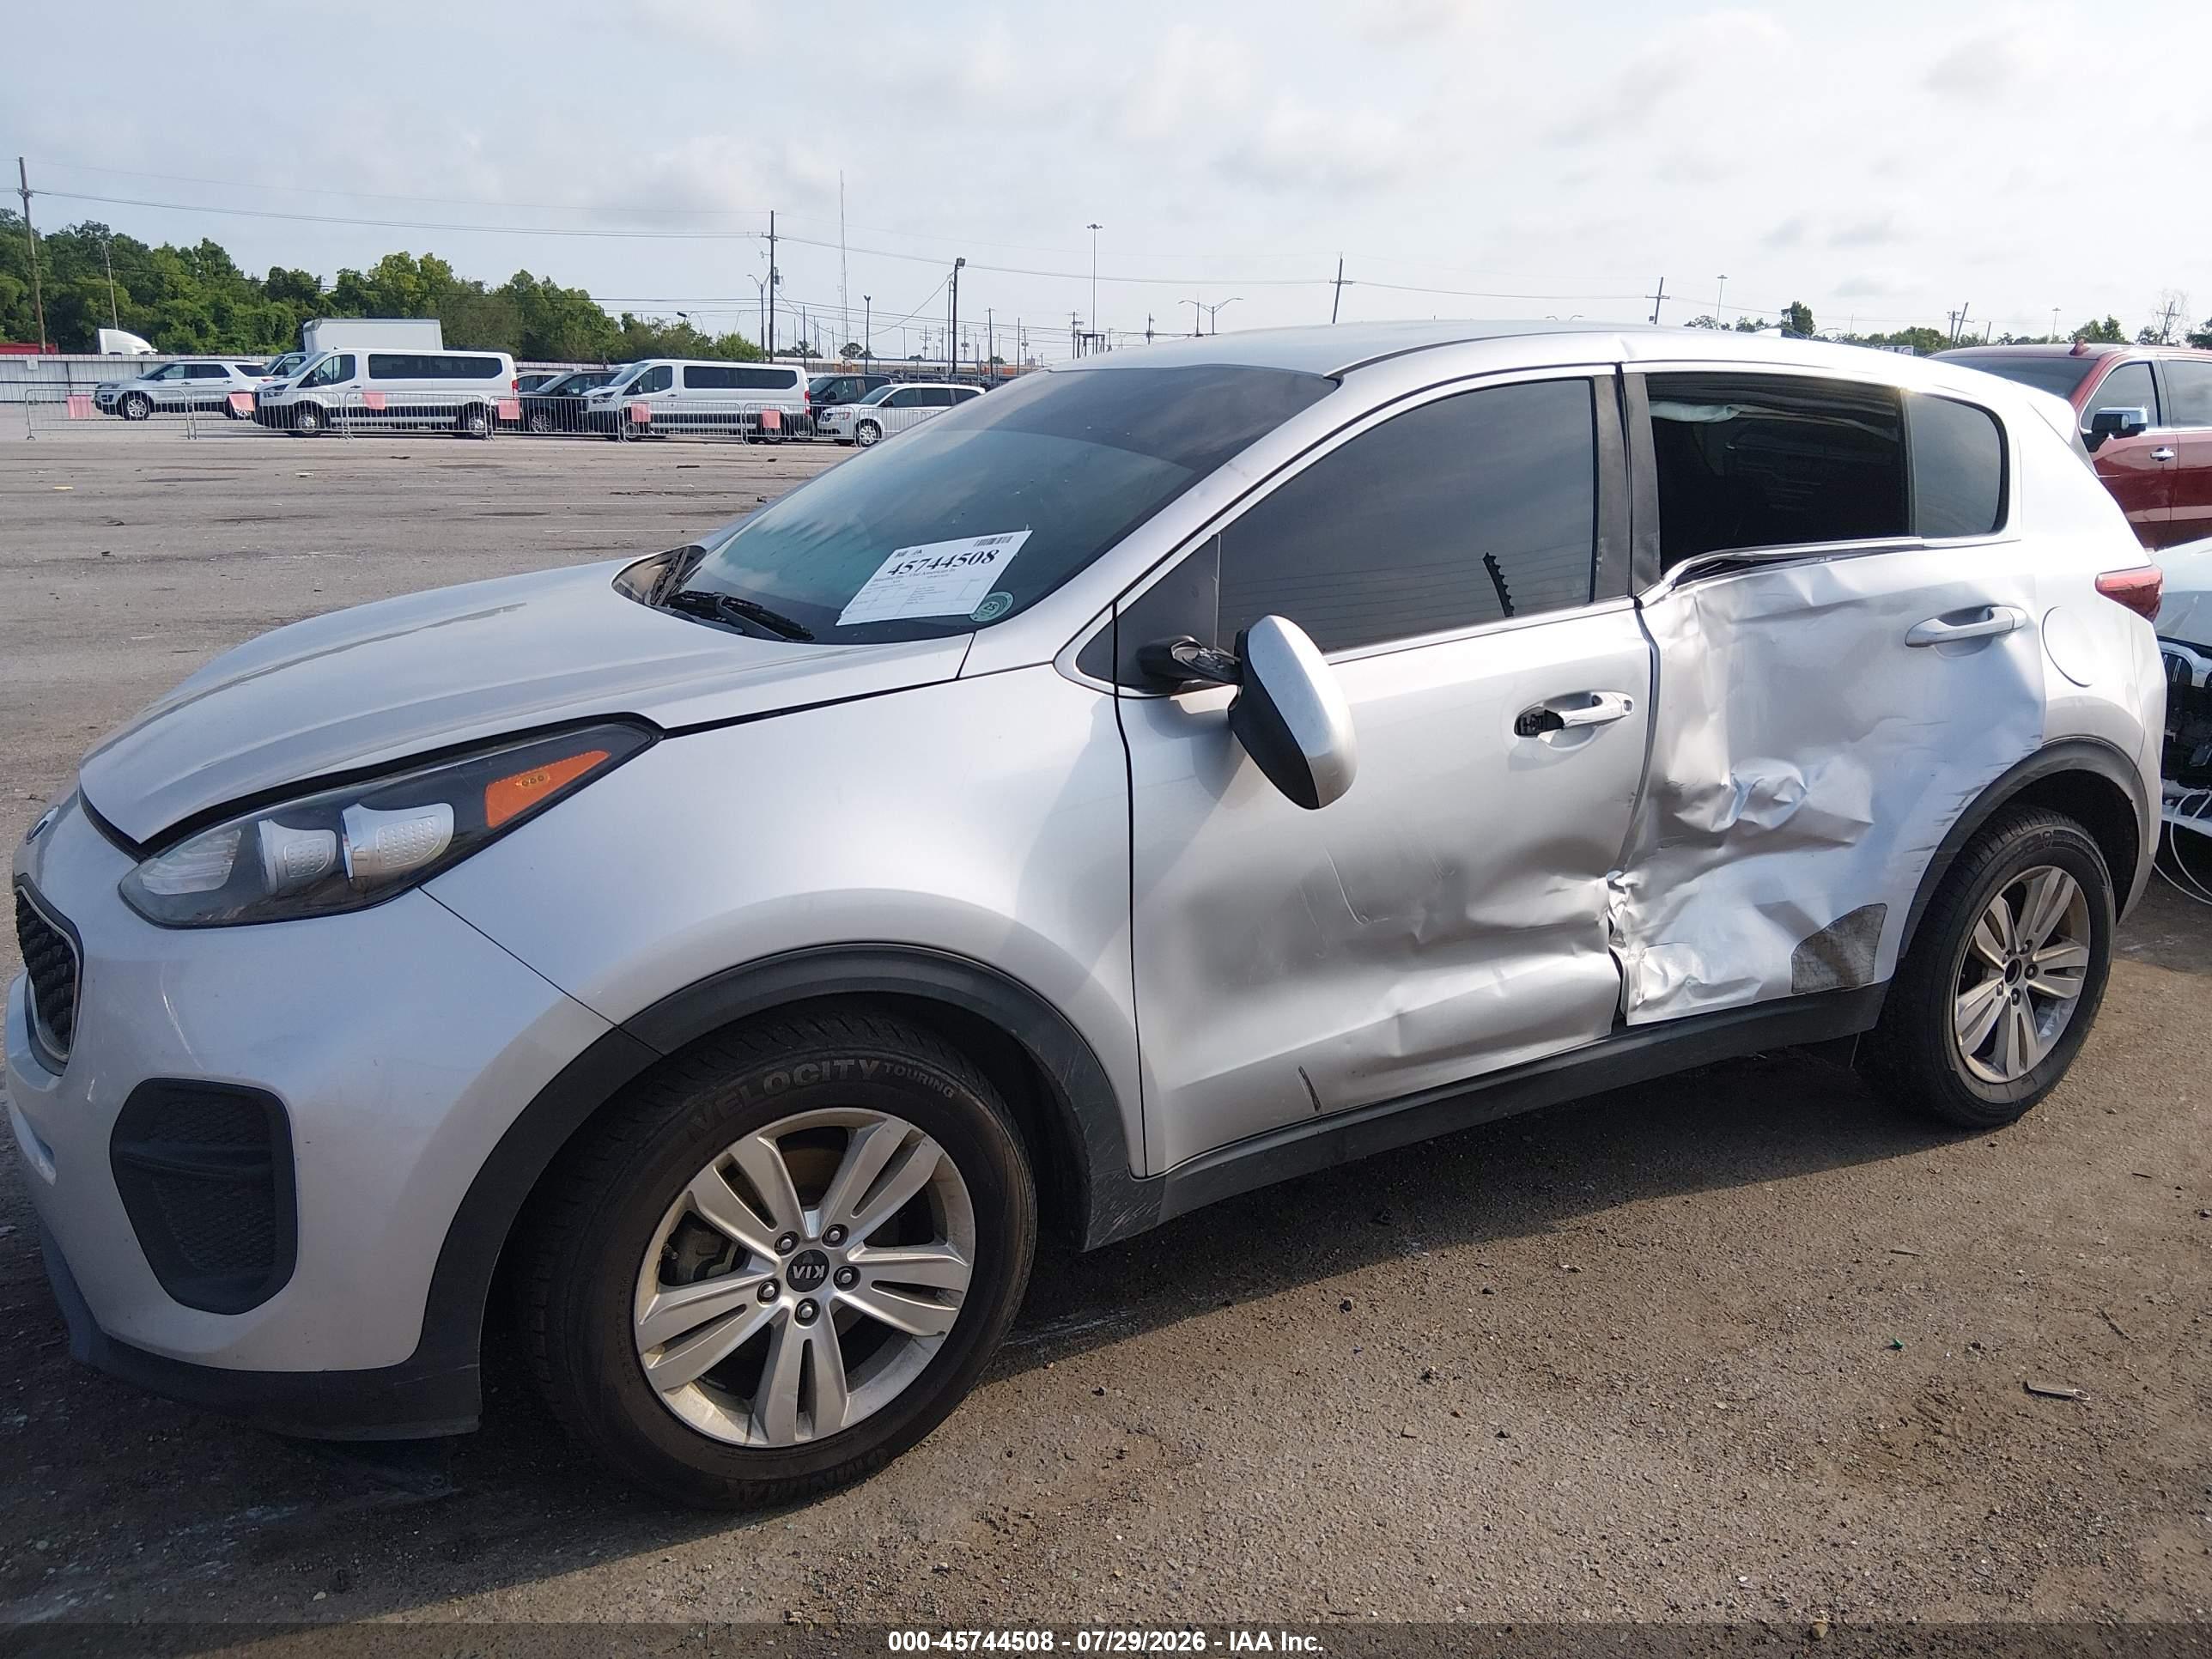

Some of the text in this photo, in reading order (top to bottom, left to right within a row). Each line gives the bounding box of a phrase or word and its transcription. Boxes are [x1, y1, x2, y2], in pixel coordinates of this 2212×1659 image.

[887, 550, 1000, 575] 45744508
[689, 1058, 955, 1132] VELOCITY TOURING
[793, 1265, 825, 1279] KIA
